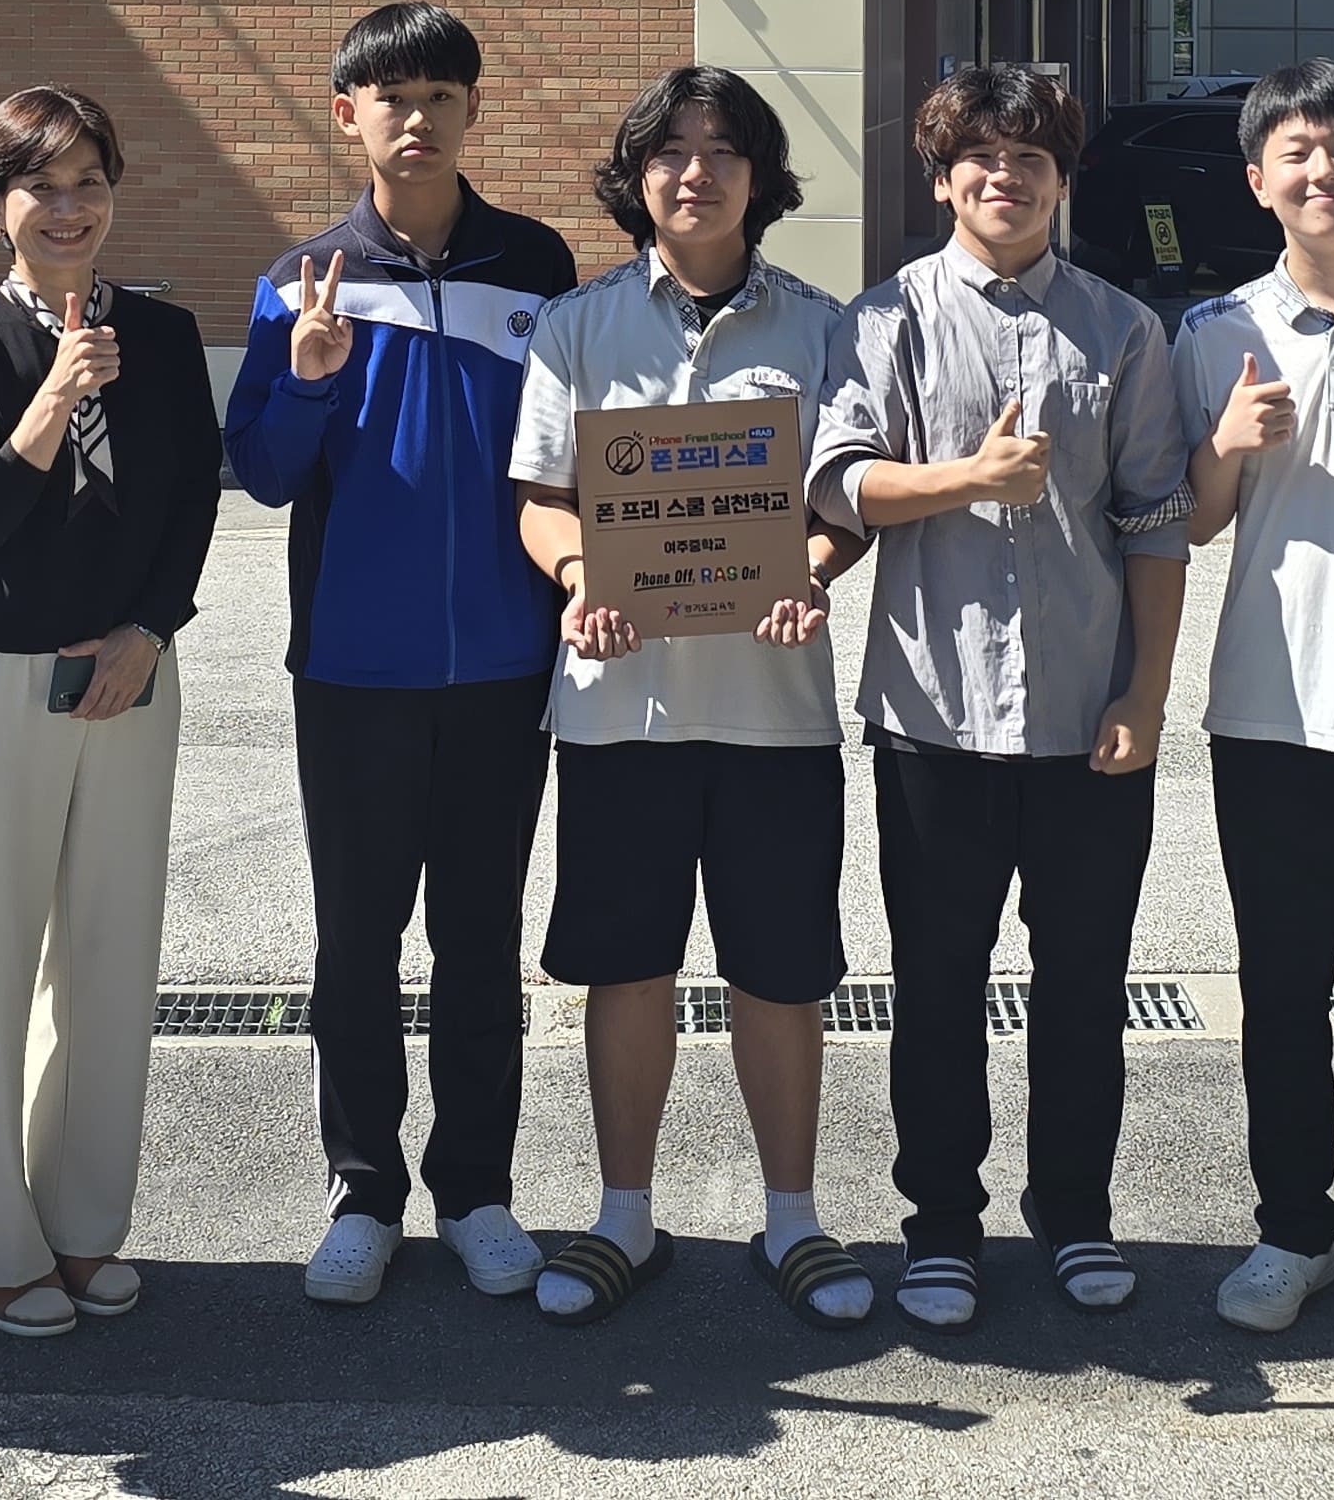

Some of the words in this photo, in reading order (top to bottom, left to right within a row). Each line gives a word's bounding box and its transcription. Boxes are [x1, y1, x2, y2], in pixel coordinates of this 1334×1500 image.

[649, 435, 683, 446] Phone
[685, 433, 709, 444] Free
[710, 430, 746, 442] School
[650, 448, 672, 473] 폰
[677, 445, 720, 470] 프리
[725, 442, 768, 466] 스쿨
[595, 502, 615, 524] 폰
[621, 499, 660, 521] 프리
[666, 496, 705, 518] 스쿨
[711, 491, 790, 516] 실천학교
[664, 537, 727, 555] 여주중학교
[634, 571, 670, 587] Phone
[674, 568, 696, 584] Off,
[700, 565, 738, 583] RAS
[741, 565, 761, 581] On!
